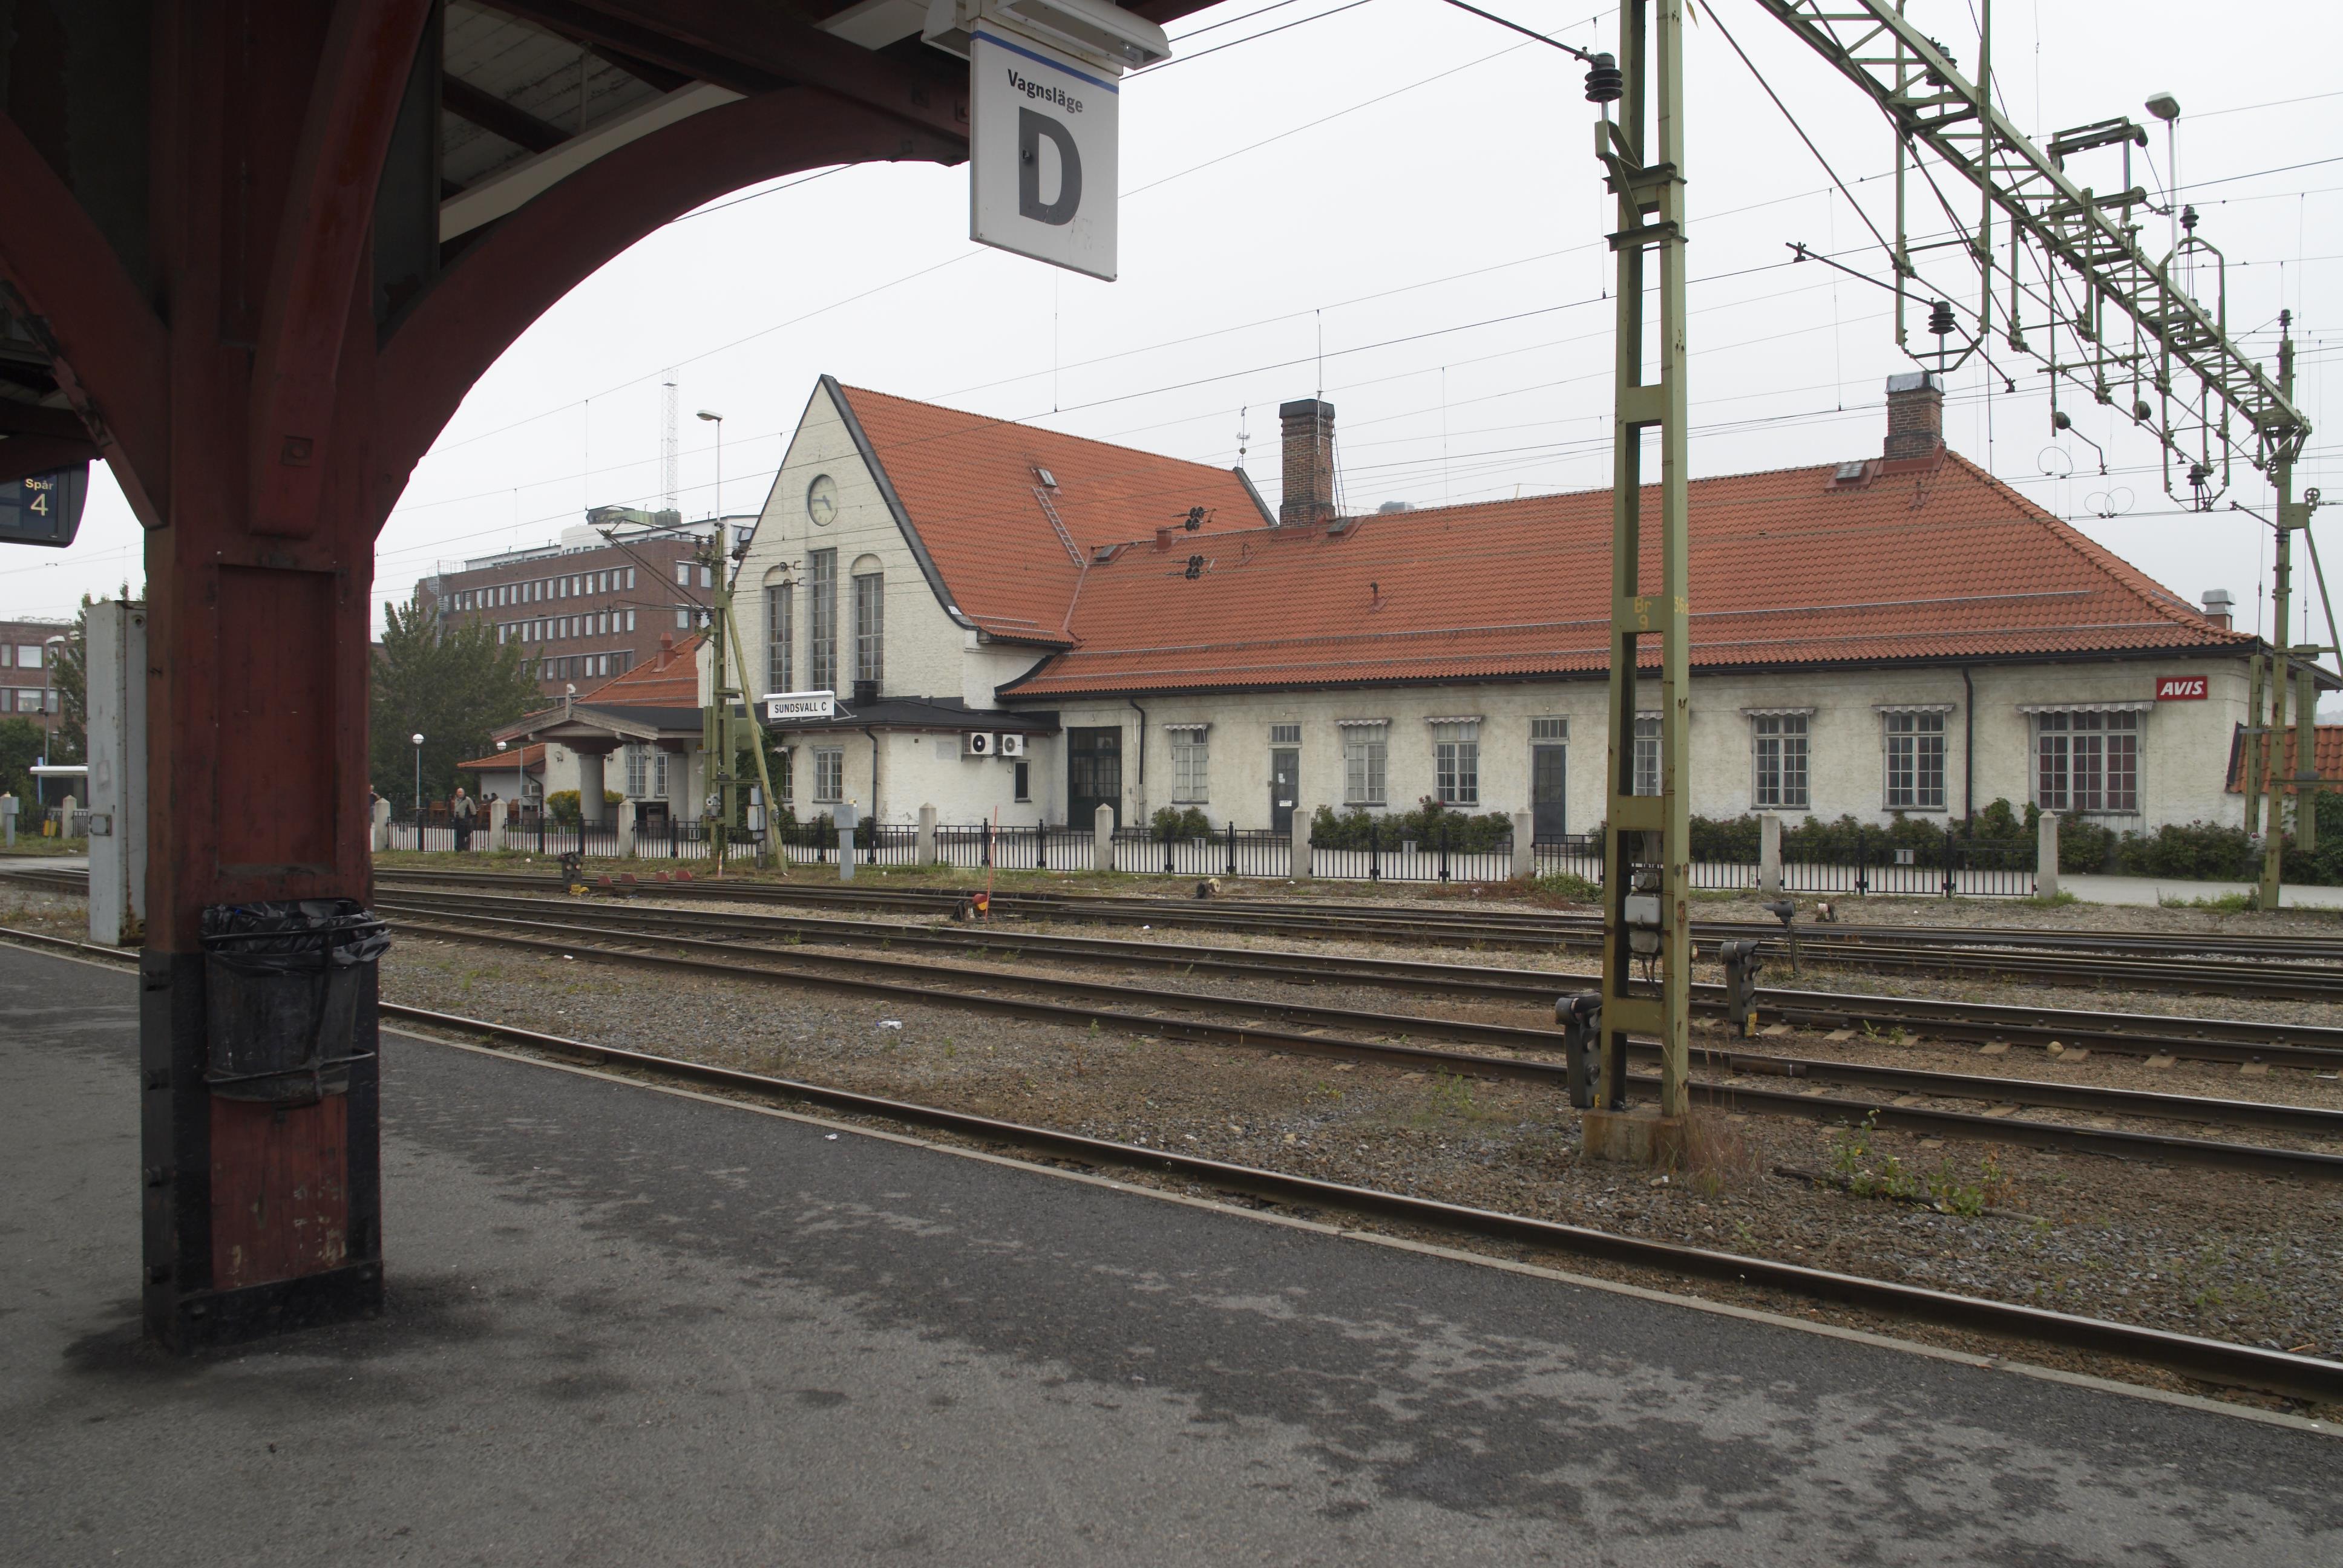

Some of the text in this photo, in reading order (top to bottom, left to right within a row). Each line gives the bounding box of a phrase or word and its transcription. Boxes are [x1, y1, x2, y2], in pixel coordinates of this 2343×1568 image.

[1008, 68, 1083, 114] Vagnsläge
[1019, 106, 1083, 226] D
[25, 478, 54, 491] Spår
[30, 493, 48, 516] 4
[1634, 596, 1652, 614] Br
[2160, 681, 2204, 696] AVIS
[775, 701, 827, 714] SUNDSVALL C
